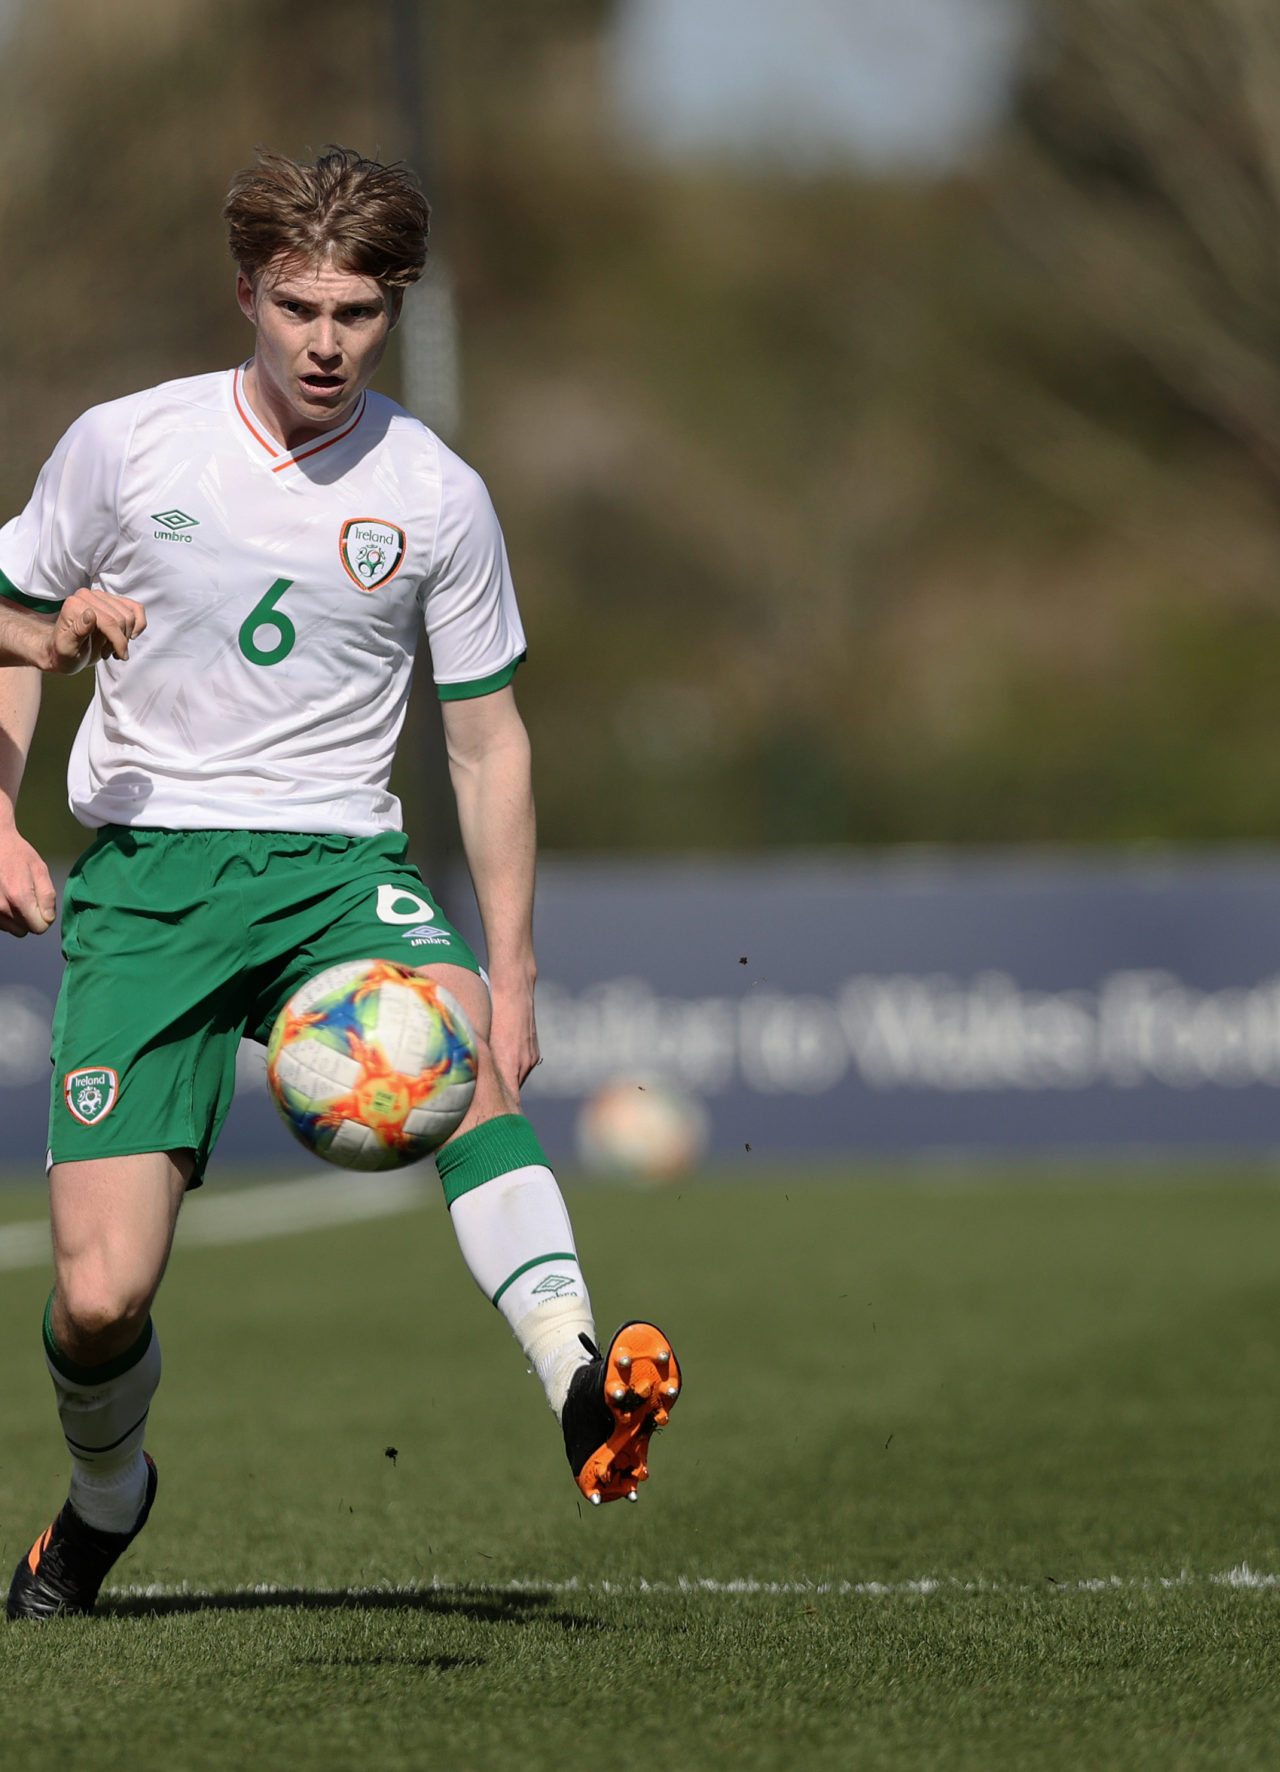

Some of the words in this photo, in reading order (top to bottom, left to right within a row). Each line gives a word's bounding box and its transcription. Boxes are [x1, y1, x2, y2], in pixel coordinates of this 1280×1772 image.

[153, 529, 193, 543] umbro
[354, 526, 394, 545] Ireland
[238, 577, 296, 667] 6
[375, 884, 435, 925] 6
[411, 938, 451, 946] umbro
[75, 1073, 105, 1087] Ireland
